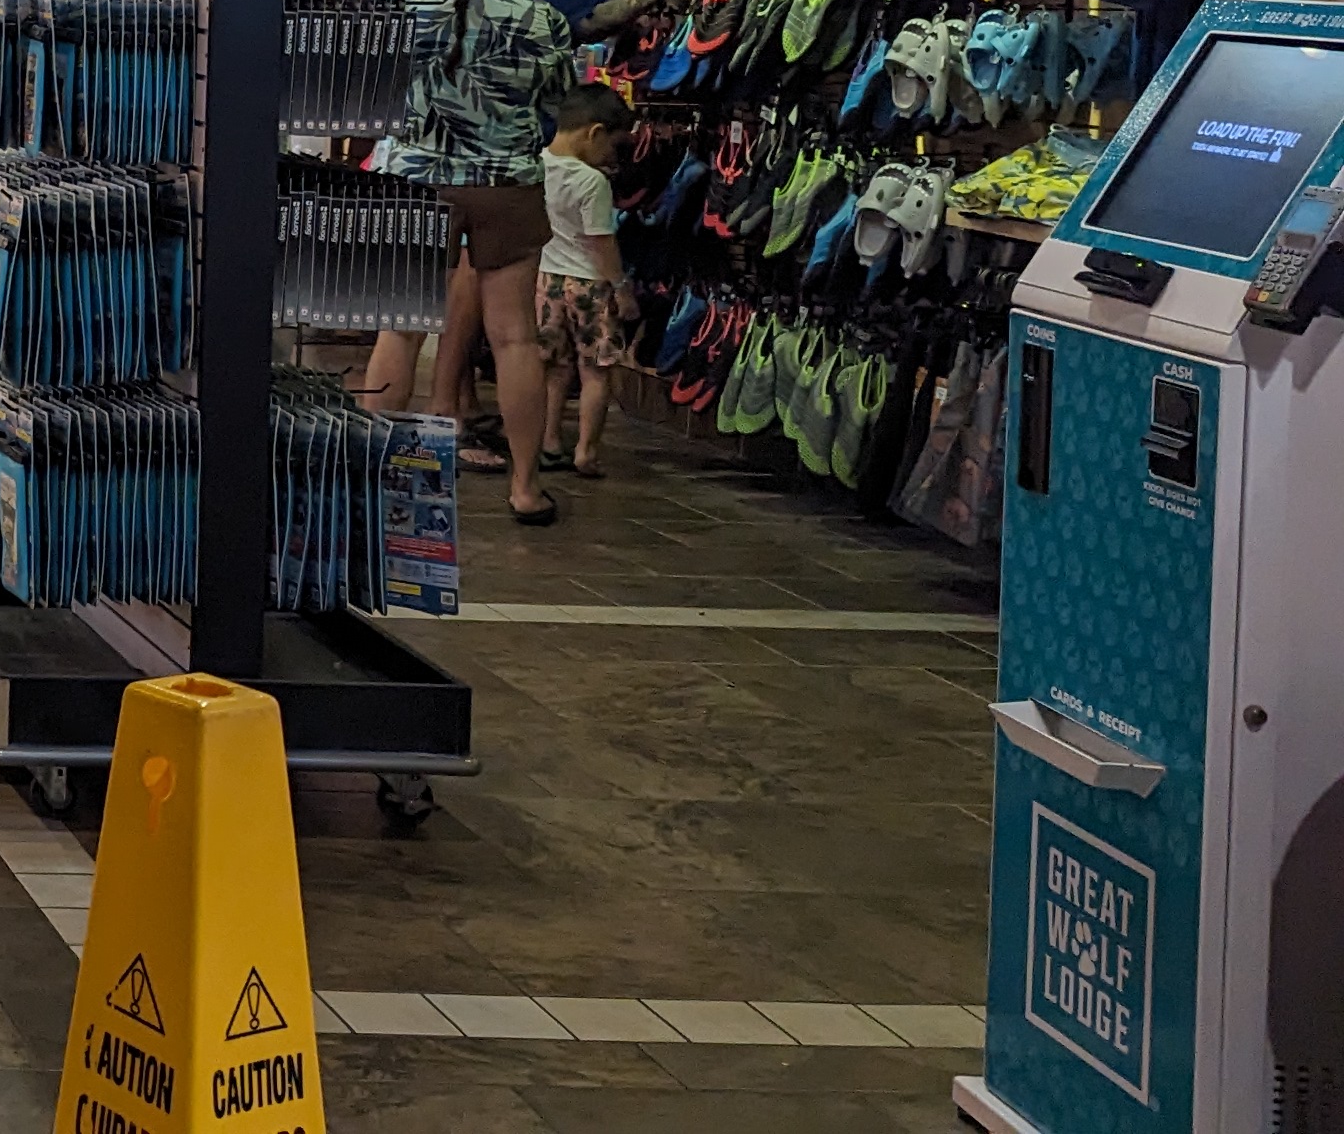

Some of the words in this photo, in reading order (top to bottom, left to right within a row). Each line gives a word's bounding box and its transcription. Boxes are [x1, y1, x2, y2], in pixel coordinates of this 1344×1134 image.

[1197, 120, 1232, 138] LOAD
[1229, 123, 1249, 139] UP
[1246, 126, 1274, 144] THE
[1268, 130, 1303, 148] FUN!
[1026, 323, 1057, 344] COINS
[1163, 361, 1194, 381] CASH
[1148, 496, 1165, 509] GIVE
[1166, 501, 1196, 520] CHANGE
[1050, 686, 1084, 713] CARDS
[1086, 704, 1095, 719] &
[1098, 710, 1143, 744] RECEIPT
[1047, 845, 1134, 938] GREAT
[1043, 952, 1131, 1056] LODGE
[212, 1052, 305, 1120] CAUTION
